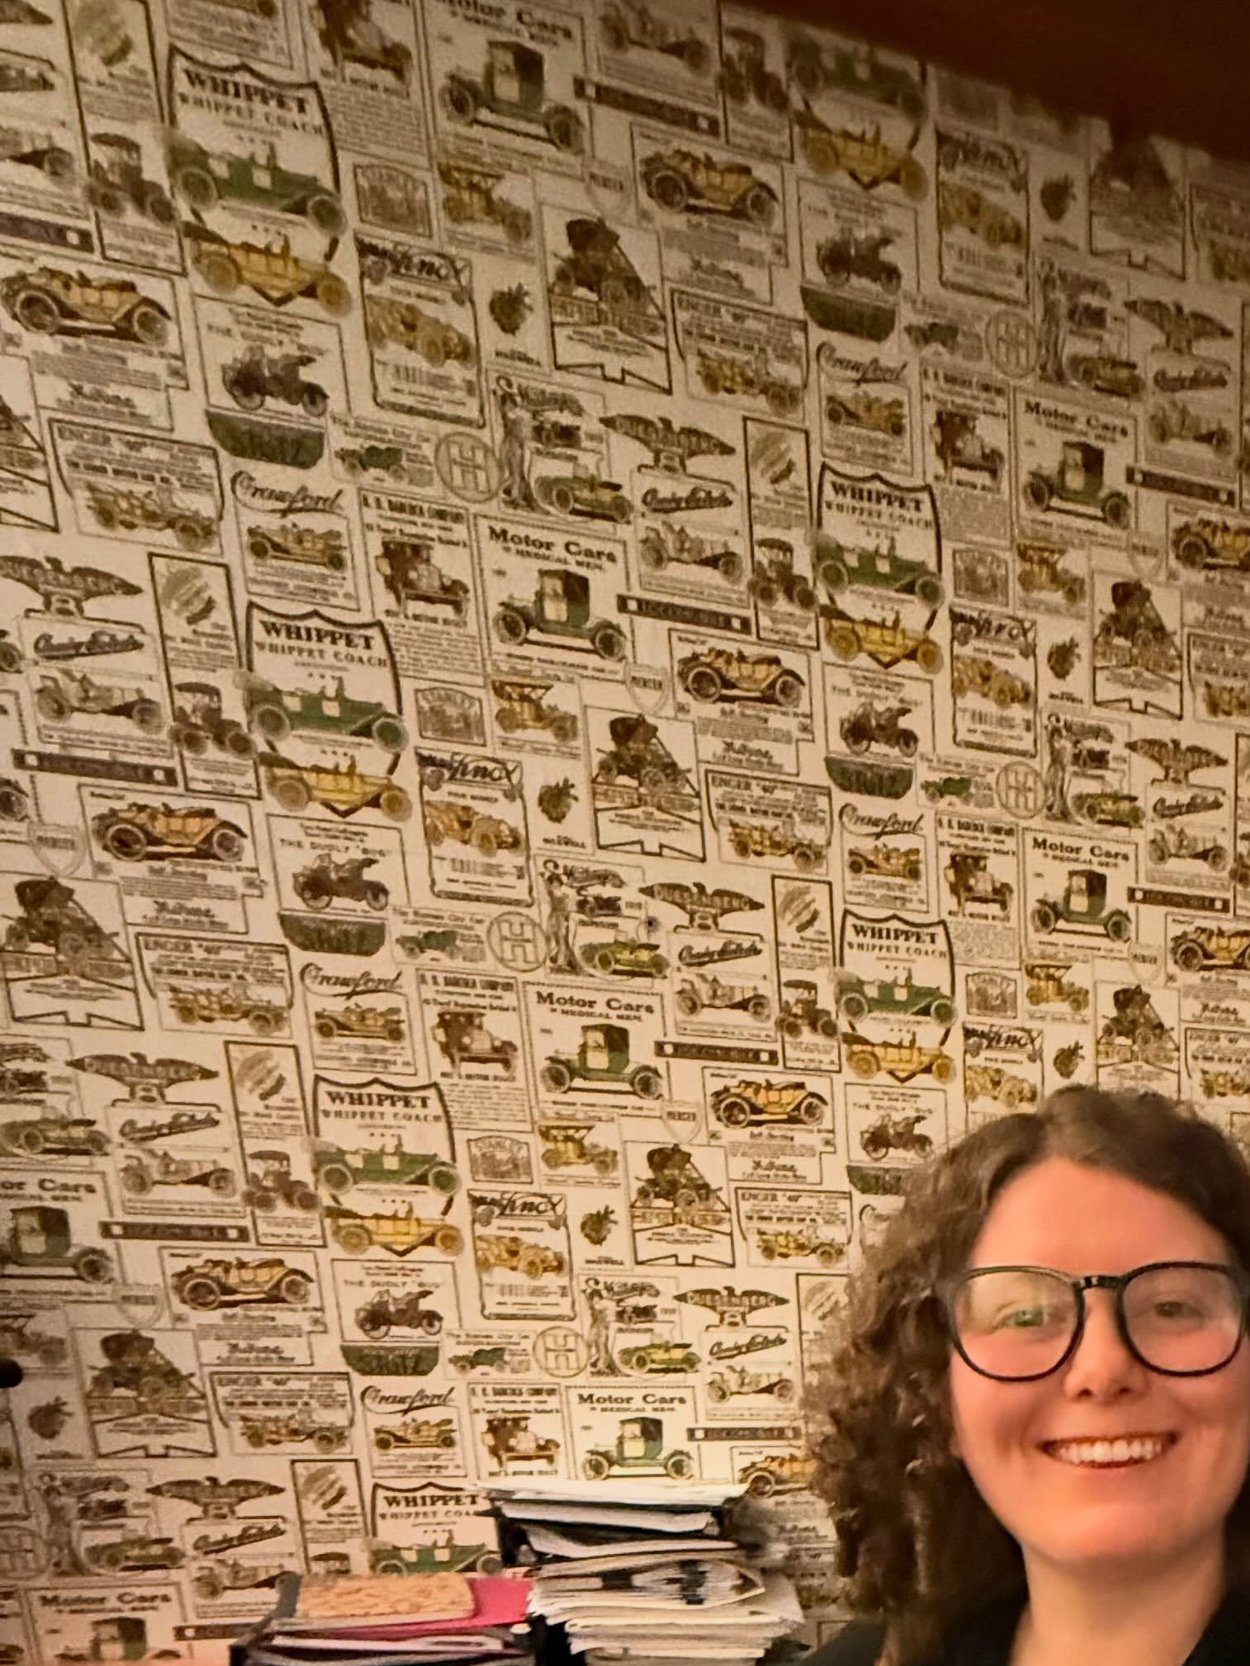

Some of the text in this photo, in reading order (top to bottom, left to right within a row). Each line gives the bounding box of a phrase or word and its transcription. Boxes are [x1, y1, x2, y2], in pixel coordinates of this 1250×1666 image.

[516, 10, 572, 40] Cars
[184, 68, 307, 113] WHIPPET
[817, 341, 908, 388] Crawford
[1024, 402, 1128, 438] Motor Cars
[230, 470, 344, 518] Crawford
[830, 480, 923, 513] WHIPPET
[488, 525, 554, 552] Motor
[564, 540, 617, 565] Cars
[260, 619, 375, 651] WHIPPET
[254, 641, 388, 668] WHIPPET COACH
[838, 803, 925, 840] Crawford
[1032, 837, 1130, 863] Motor Cars
[852, 923, 939, 944] WHIPPET
[905, 944, 948, 960] COACH
[300, 961, 402, 1000] Crawford
[536, 990, 655, 1015] Motor Cars
[324, 1090, 430, 1110] WHIPPET
[320, 1108, 443, 1124] WHIPPET COACH
[38, 1178, 97, 1196] Cars
[360, 1384, 455, 1416] Crawford
[577, 1393, 687, 1405] Motor Cars
[383, 1493, 479, 1508] WHIPPET
[117, 1591, 172, 1604] Cars
